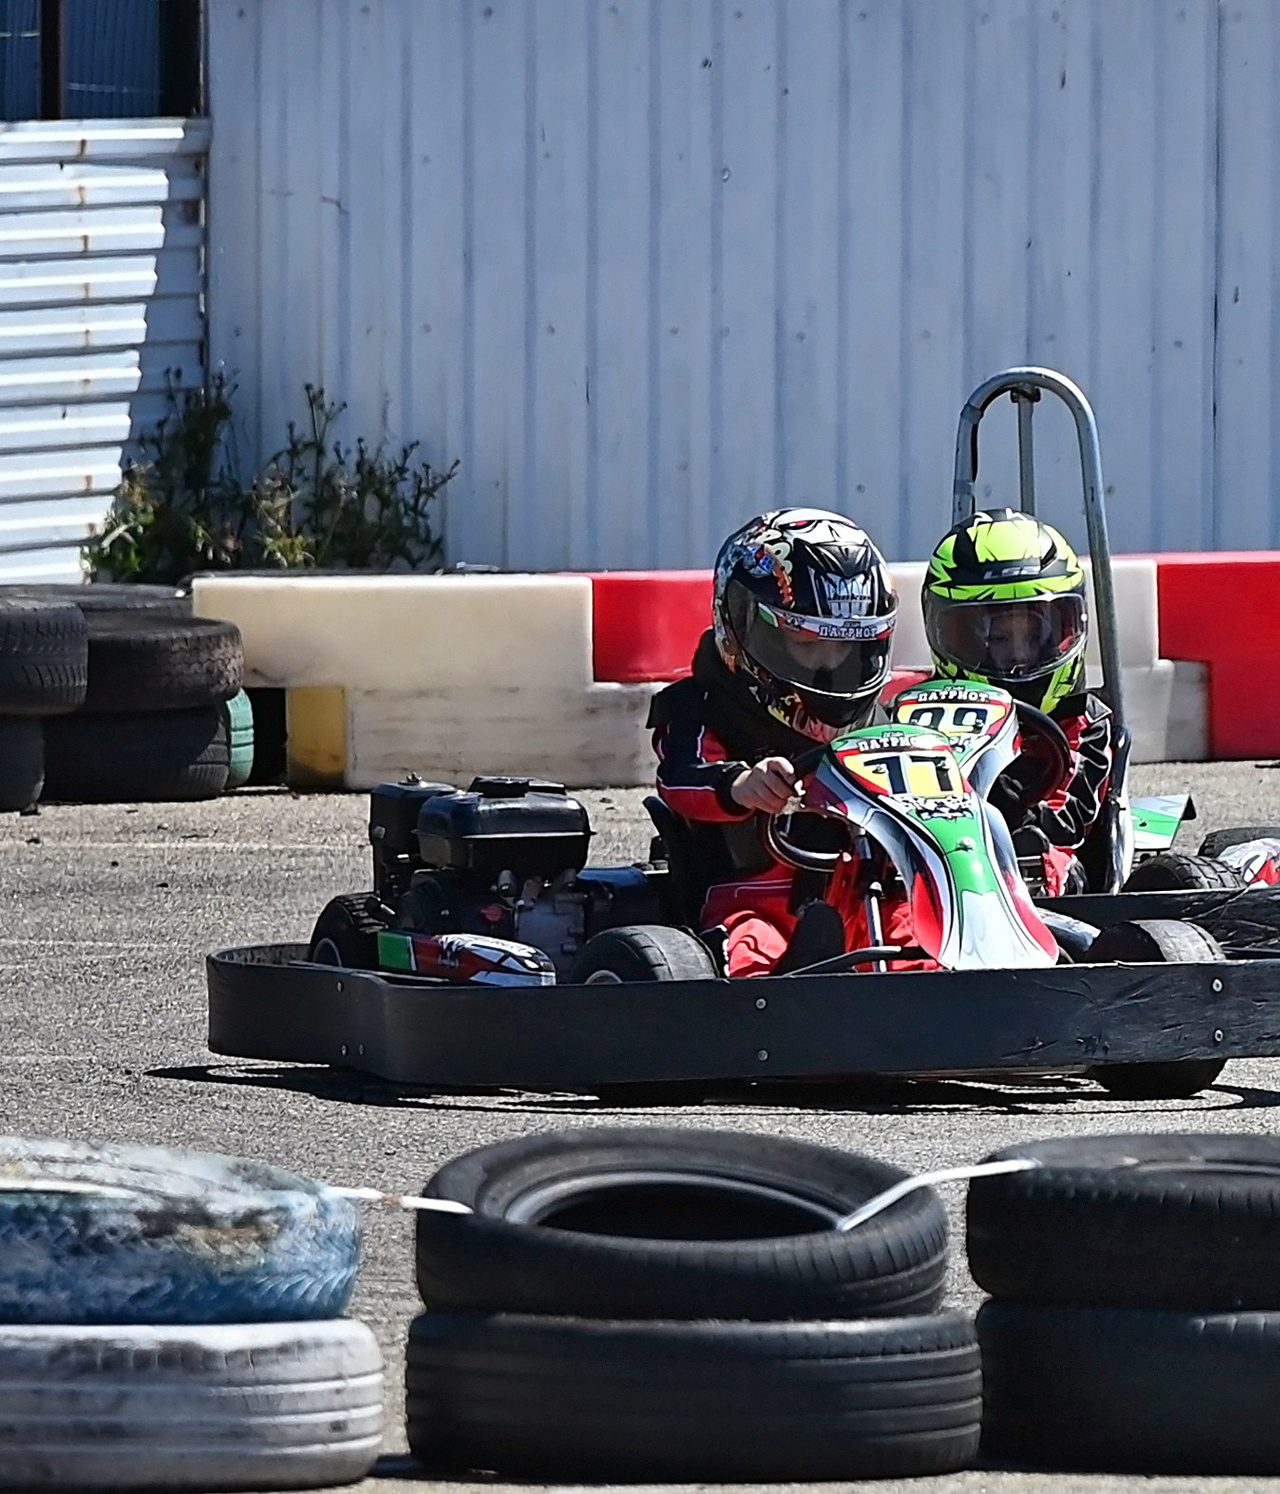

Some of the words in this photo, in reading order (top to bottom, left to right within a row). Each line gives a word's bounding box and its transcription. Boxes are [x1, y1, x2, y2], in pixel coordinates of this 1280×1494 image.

[819, 625, 878, 639] ПАТРИОТ
[918, 689, 989, 702] ПАТРИОТ
[857, 737, 926, 752] ПАТРИО
